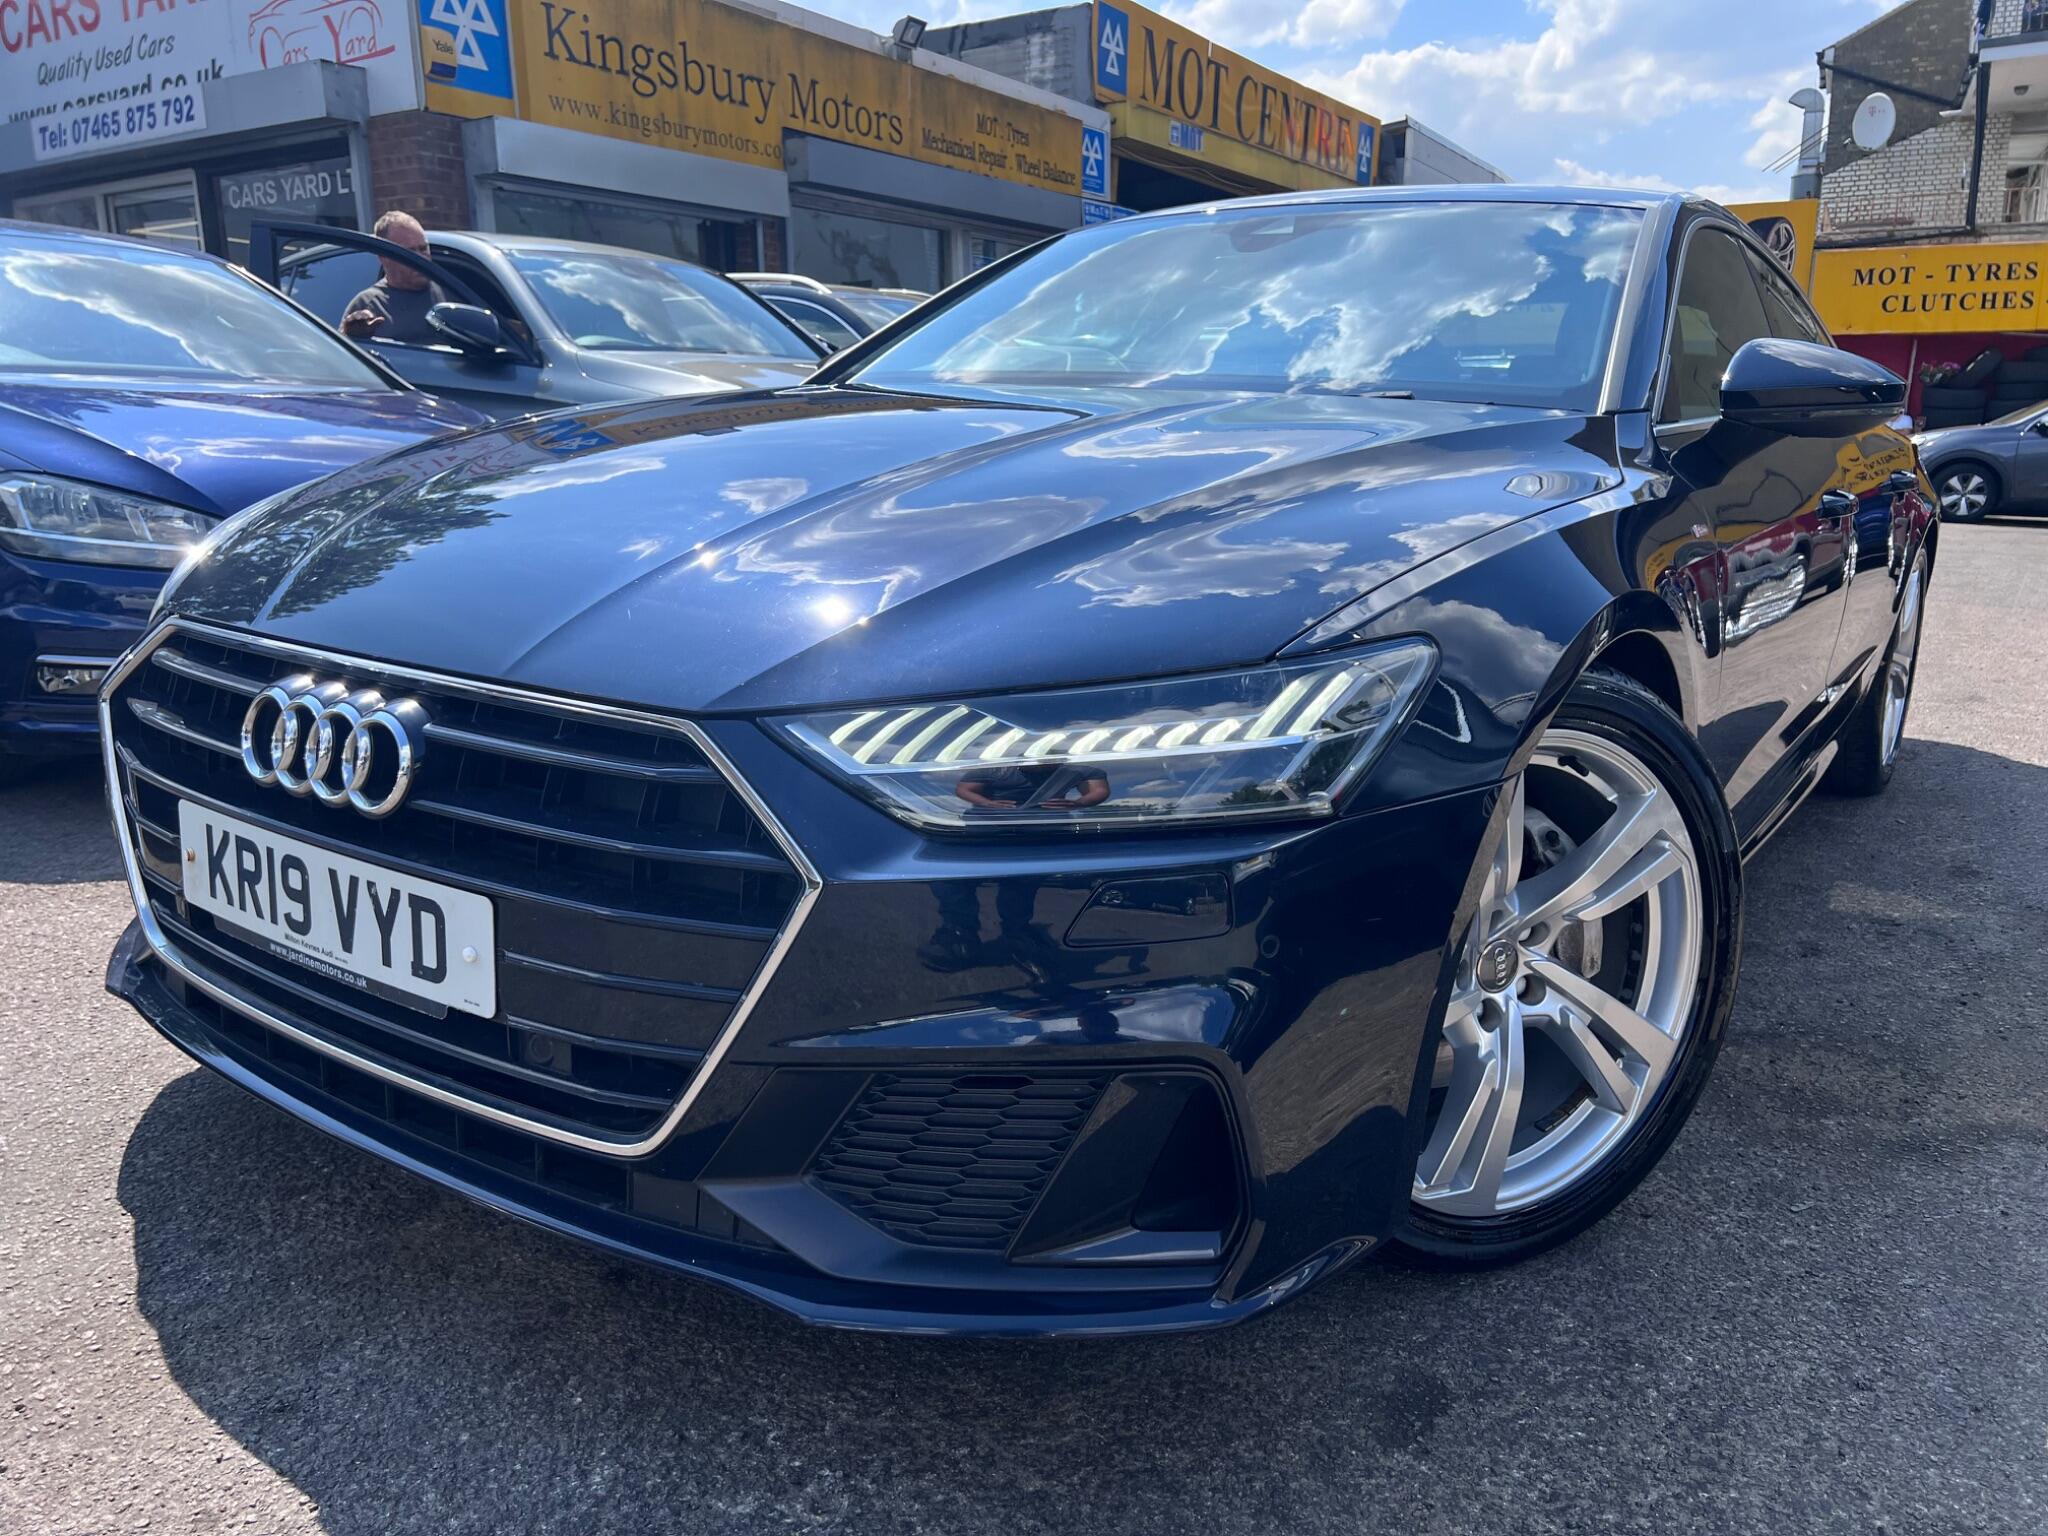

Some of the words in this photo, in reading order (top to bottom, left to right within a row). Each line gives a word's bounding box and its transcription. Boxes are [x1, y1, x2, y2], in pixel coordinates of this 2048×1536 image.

[38, 54, 92, 86] Quality
[95, 34, 134, 71] Used
[138, 34, 175, 60] Cars
[432, 38, 453, 55] Yale
[540, 2, 776, 124] Kingsbury
[787, 73, 904, 146] Motors
[39, 125, 67, 150] Tel:
[72, 112, 121, 145] 07465
[126, 104, 157, 134] 875
[162, 95, 195, 126] 792
[1139, 25, 1229, 131] MOT
[1235, 75, 1350, 176] CENTRE
[228, 178, 278, 209] CARS
[281, 171, 331, 201] YARD
[1853, 266, 1916, 287] MOT
[1946, 261, 2039, 283] TYRES
[1880, 290, 2035, 314] CLUTCHES
[205, 823, 313, 937] KR19
[327, 867, 448, 985] VYD
[269, 942, 368, 989] www.jardinemotors.co.uk
